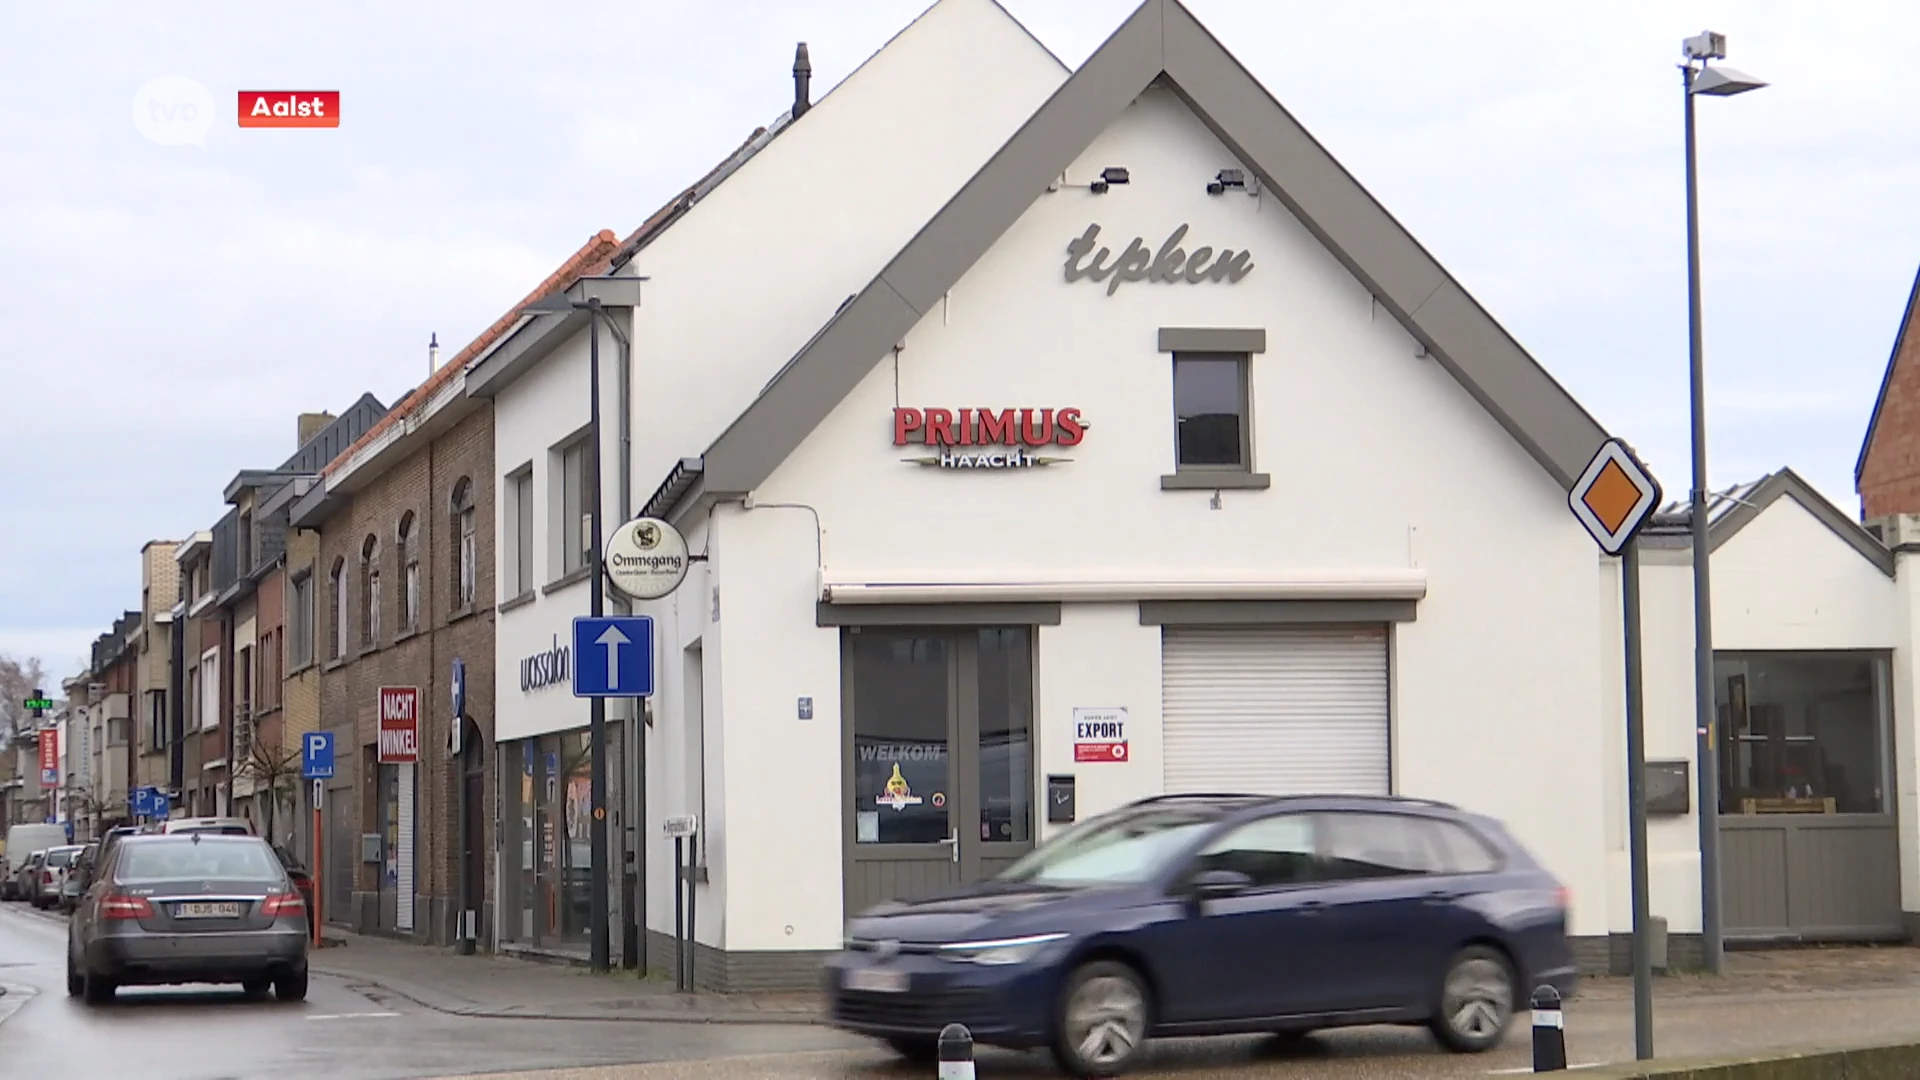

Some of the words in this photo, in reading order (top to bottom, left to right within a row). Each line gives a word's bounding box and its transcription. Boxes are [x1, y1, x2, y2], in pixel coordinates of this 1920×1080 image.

[893, 407, 1086, 447] PRIMUS
[940, 453, 1038, 469] HAACHT
[612, 553, 681, 568] Ommegang
[520, 633, 571, 691] wassalon
[383, 694, 414, 720] NACHT
[1077, 722, 1124, 738] EXPORT
[310, 736, 326, 760] P
[382, 729, 416, 756] WINKEL
[859, 745, 939, 761] WELKOM
[135, 791, 148, 806] P
[154, 797, 165, 811] P
